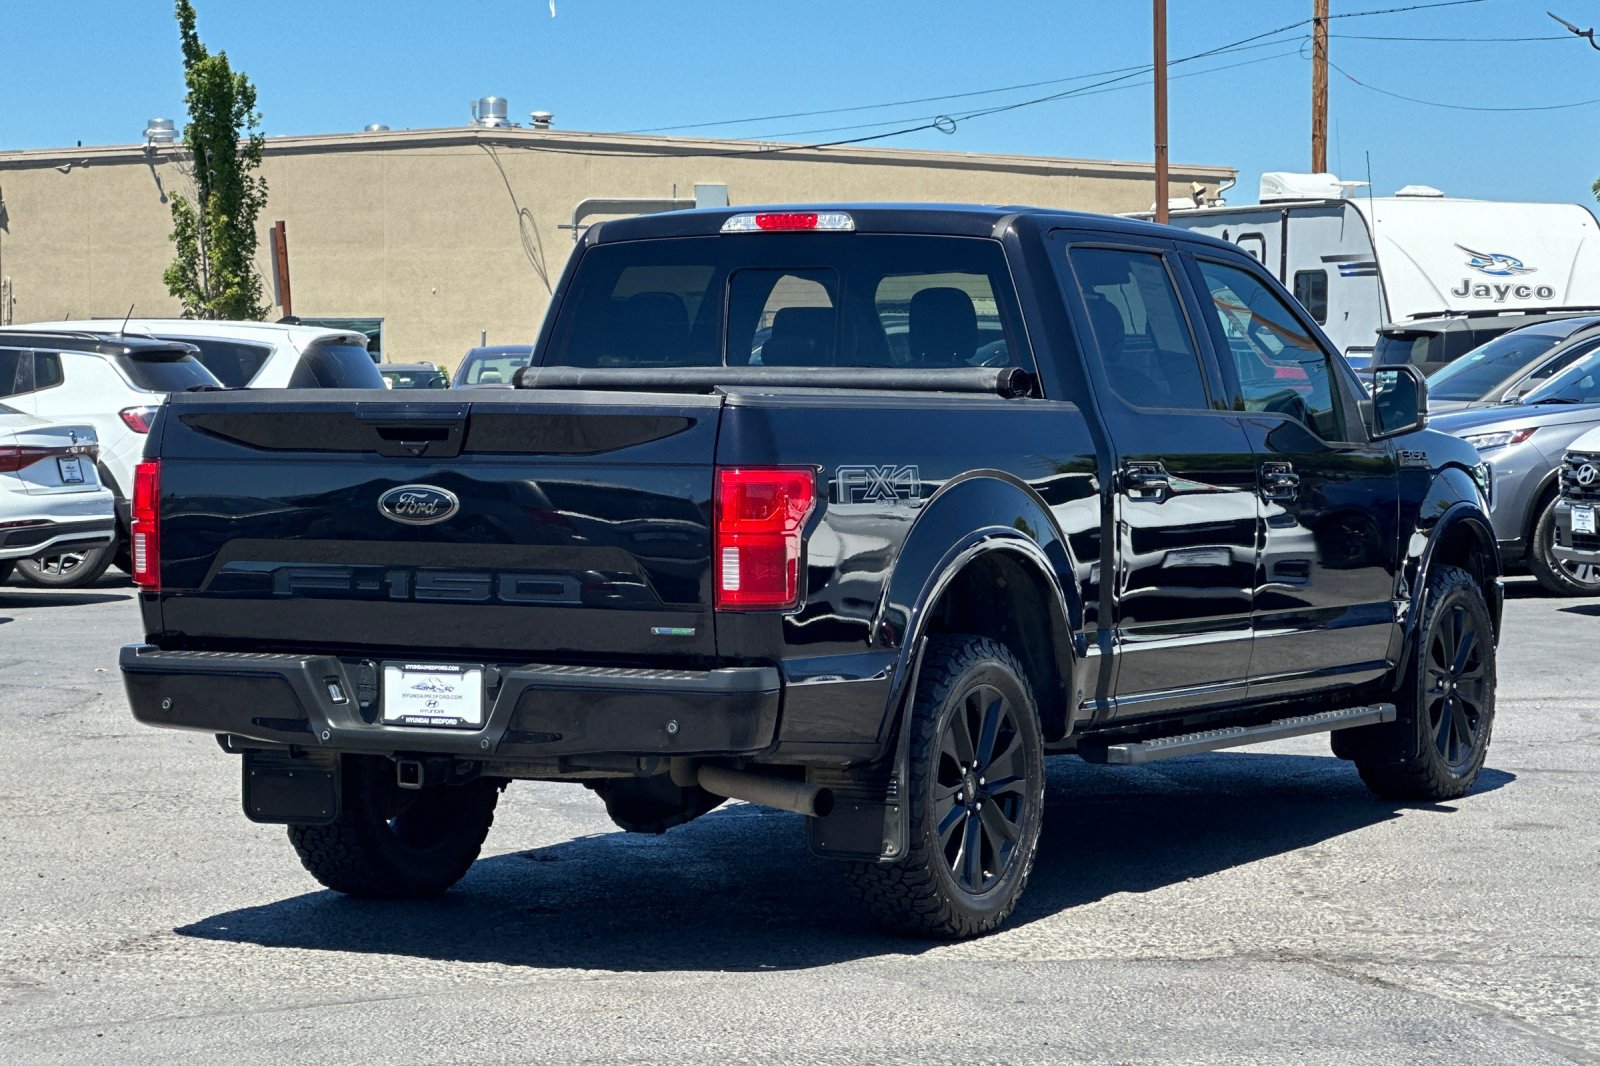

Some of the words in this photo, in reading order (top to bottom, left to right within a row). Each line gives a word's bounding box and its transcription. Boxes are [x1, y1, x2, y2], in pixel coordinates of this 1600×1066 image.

[1451, 278, 1556, 303] Jayco
[836, 465, 921, 504] FX4
[395, 492, 439, 515] Ford
[271, 566, 584, 604] F-150
[405, 664, 460, 672] HYUNDAIMEDFORD.COM
